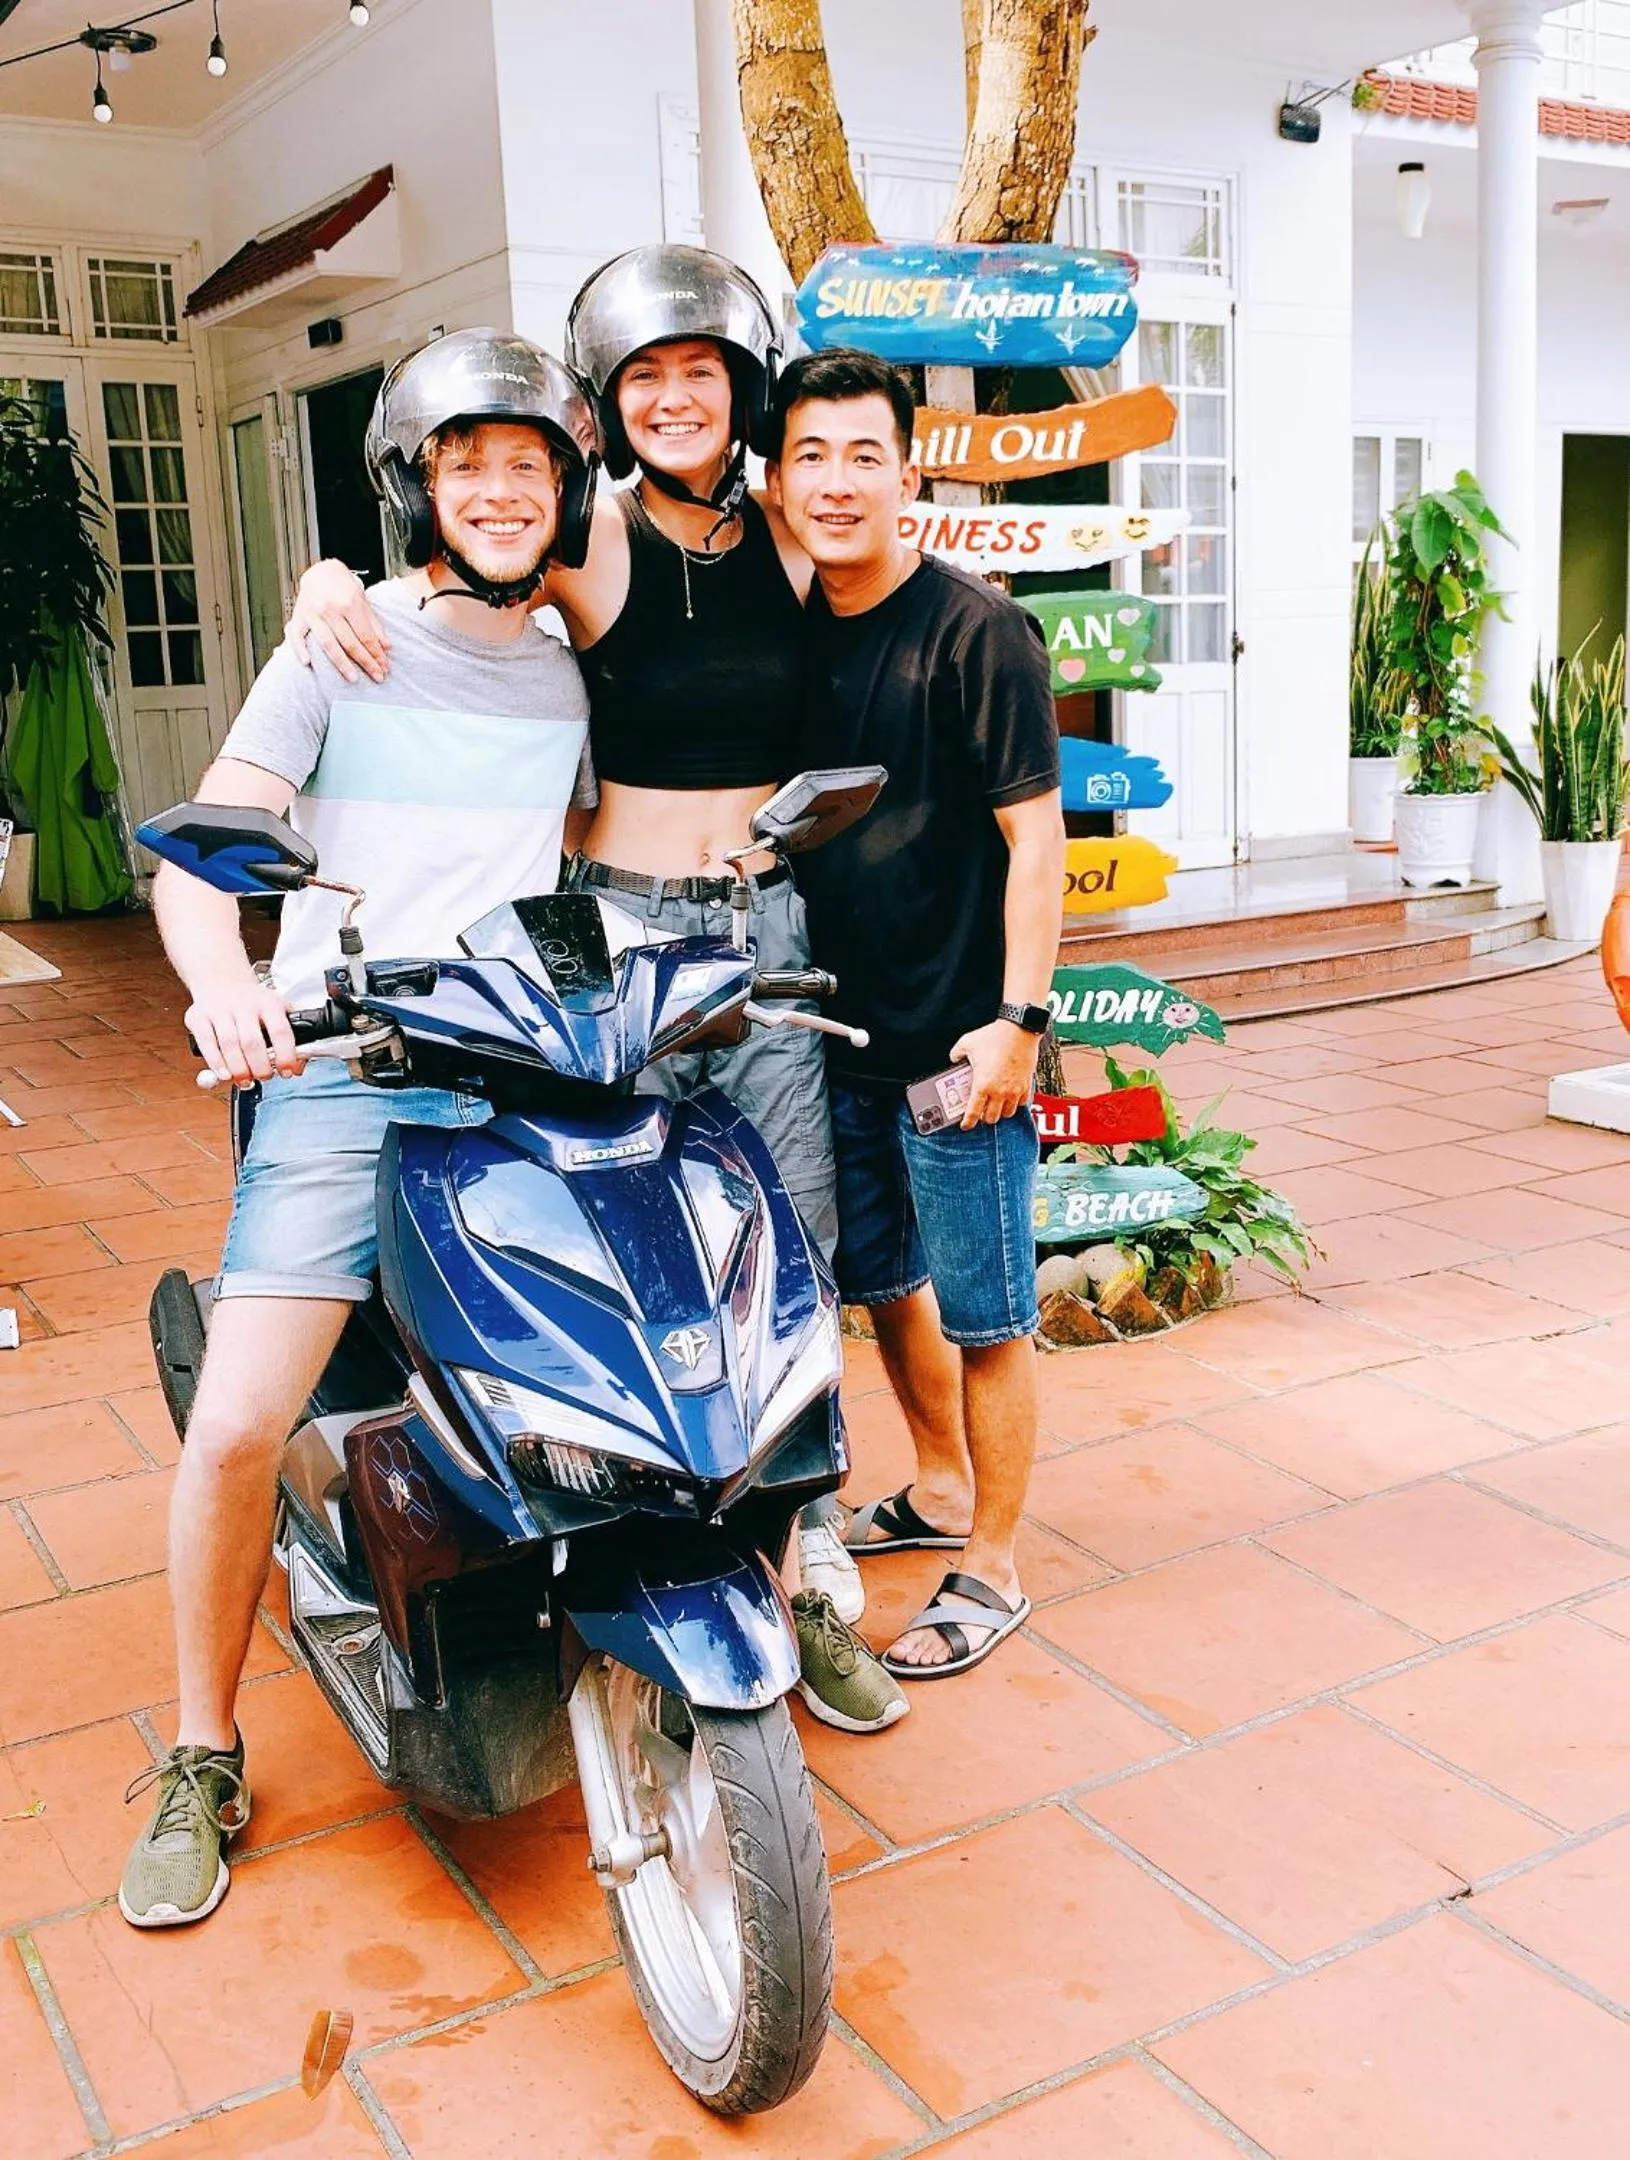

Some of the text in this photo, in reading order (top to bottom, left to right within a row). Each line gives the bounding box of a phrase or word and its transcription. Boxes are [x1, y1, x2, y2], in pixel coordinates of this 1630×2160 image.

[816, 277, 951, 318] SUNSET
[1056, 281, 1129, 318] town
[990, 421, 1086, 464] Out
[1039, 613, 1113, 651] AN
[572, 1141, 654, 1164] HONDA
[1064, 1190, 1175, 1227] BEACH
